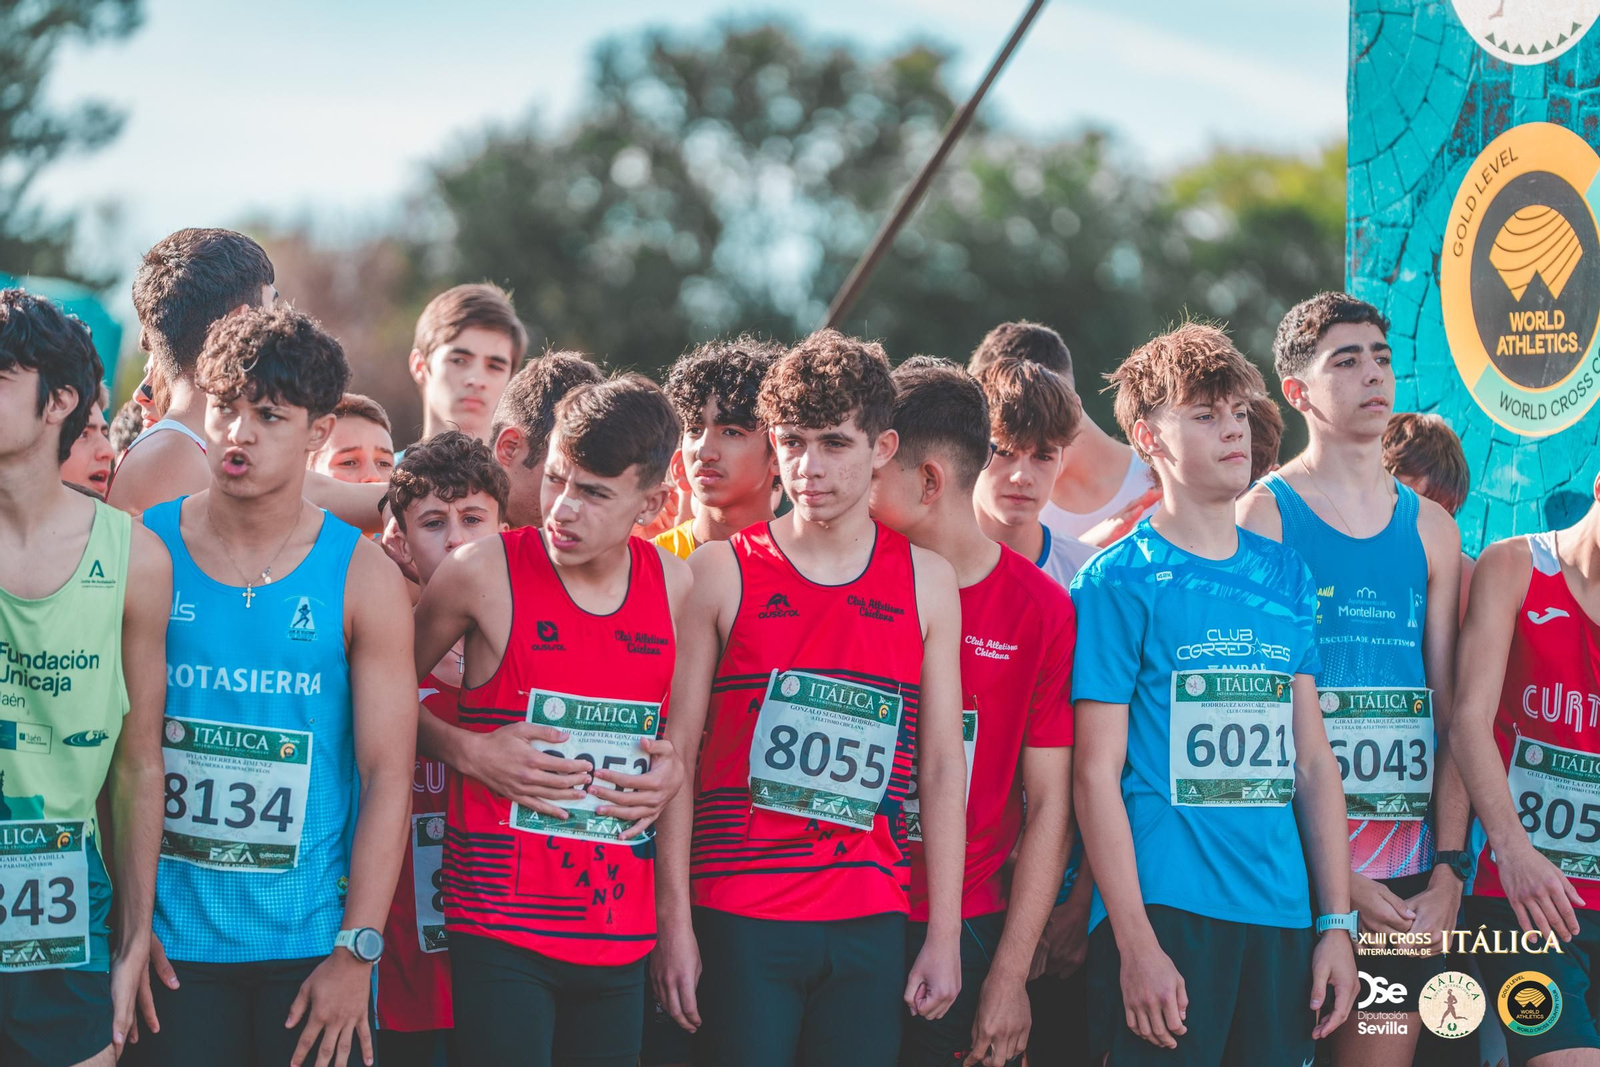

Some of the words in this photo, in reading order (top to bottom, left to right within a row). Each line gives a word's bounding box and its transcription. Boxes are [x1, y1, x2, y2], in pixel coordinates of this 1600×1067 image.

[1453, 195, 1477, 257] GOLD
[1474, 147, 1518, 195] LEVEL
[1509, 309, 1565, 332] WORLD
[1496, 331, 1578, 356] ATHLETICS
[1500, 390, 1547, 420] WORLD
[1550, 372, 1594, 416] CROSS
[847, 595, 866, 607] Club
[859, 606, 894, 622] Chiclana
[965, 635, 984, 646] Club
[1207, 629, 1253, 641] CLUB
[0, 641, 99, 670] Fundación
[975, 646, 1010, 660] Chiclana
[1216, 674, 1272, 692] ITÁLICA
[0, 691, 26, 708] aén
[809, 683, 874, 710] ITÁLICA
[1349, 691, 1407, 708] ITÁLICA
[576, 703, 638, 724] ITÁLICA
[790, 704, 822, 715] GONZALO
[823, 711, 851, 721] SEGUNDO
[193, 726, 269, 751] ITÁLICA
[1186, 723, 1290, 768] 6021
[186, 753, 208, 762] DYLAN
[208, 755, 241, 765] HERRERA
[765, 724, 886, 789] 8055
[165, 772, 293, 833] 8134
[1518, 791, 1600, 843] 805
[0, 828, 47, 845] LICA
